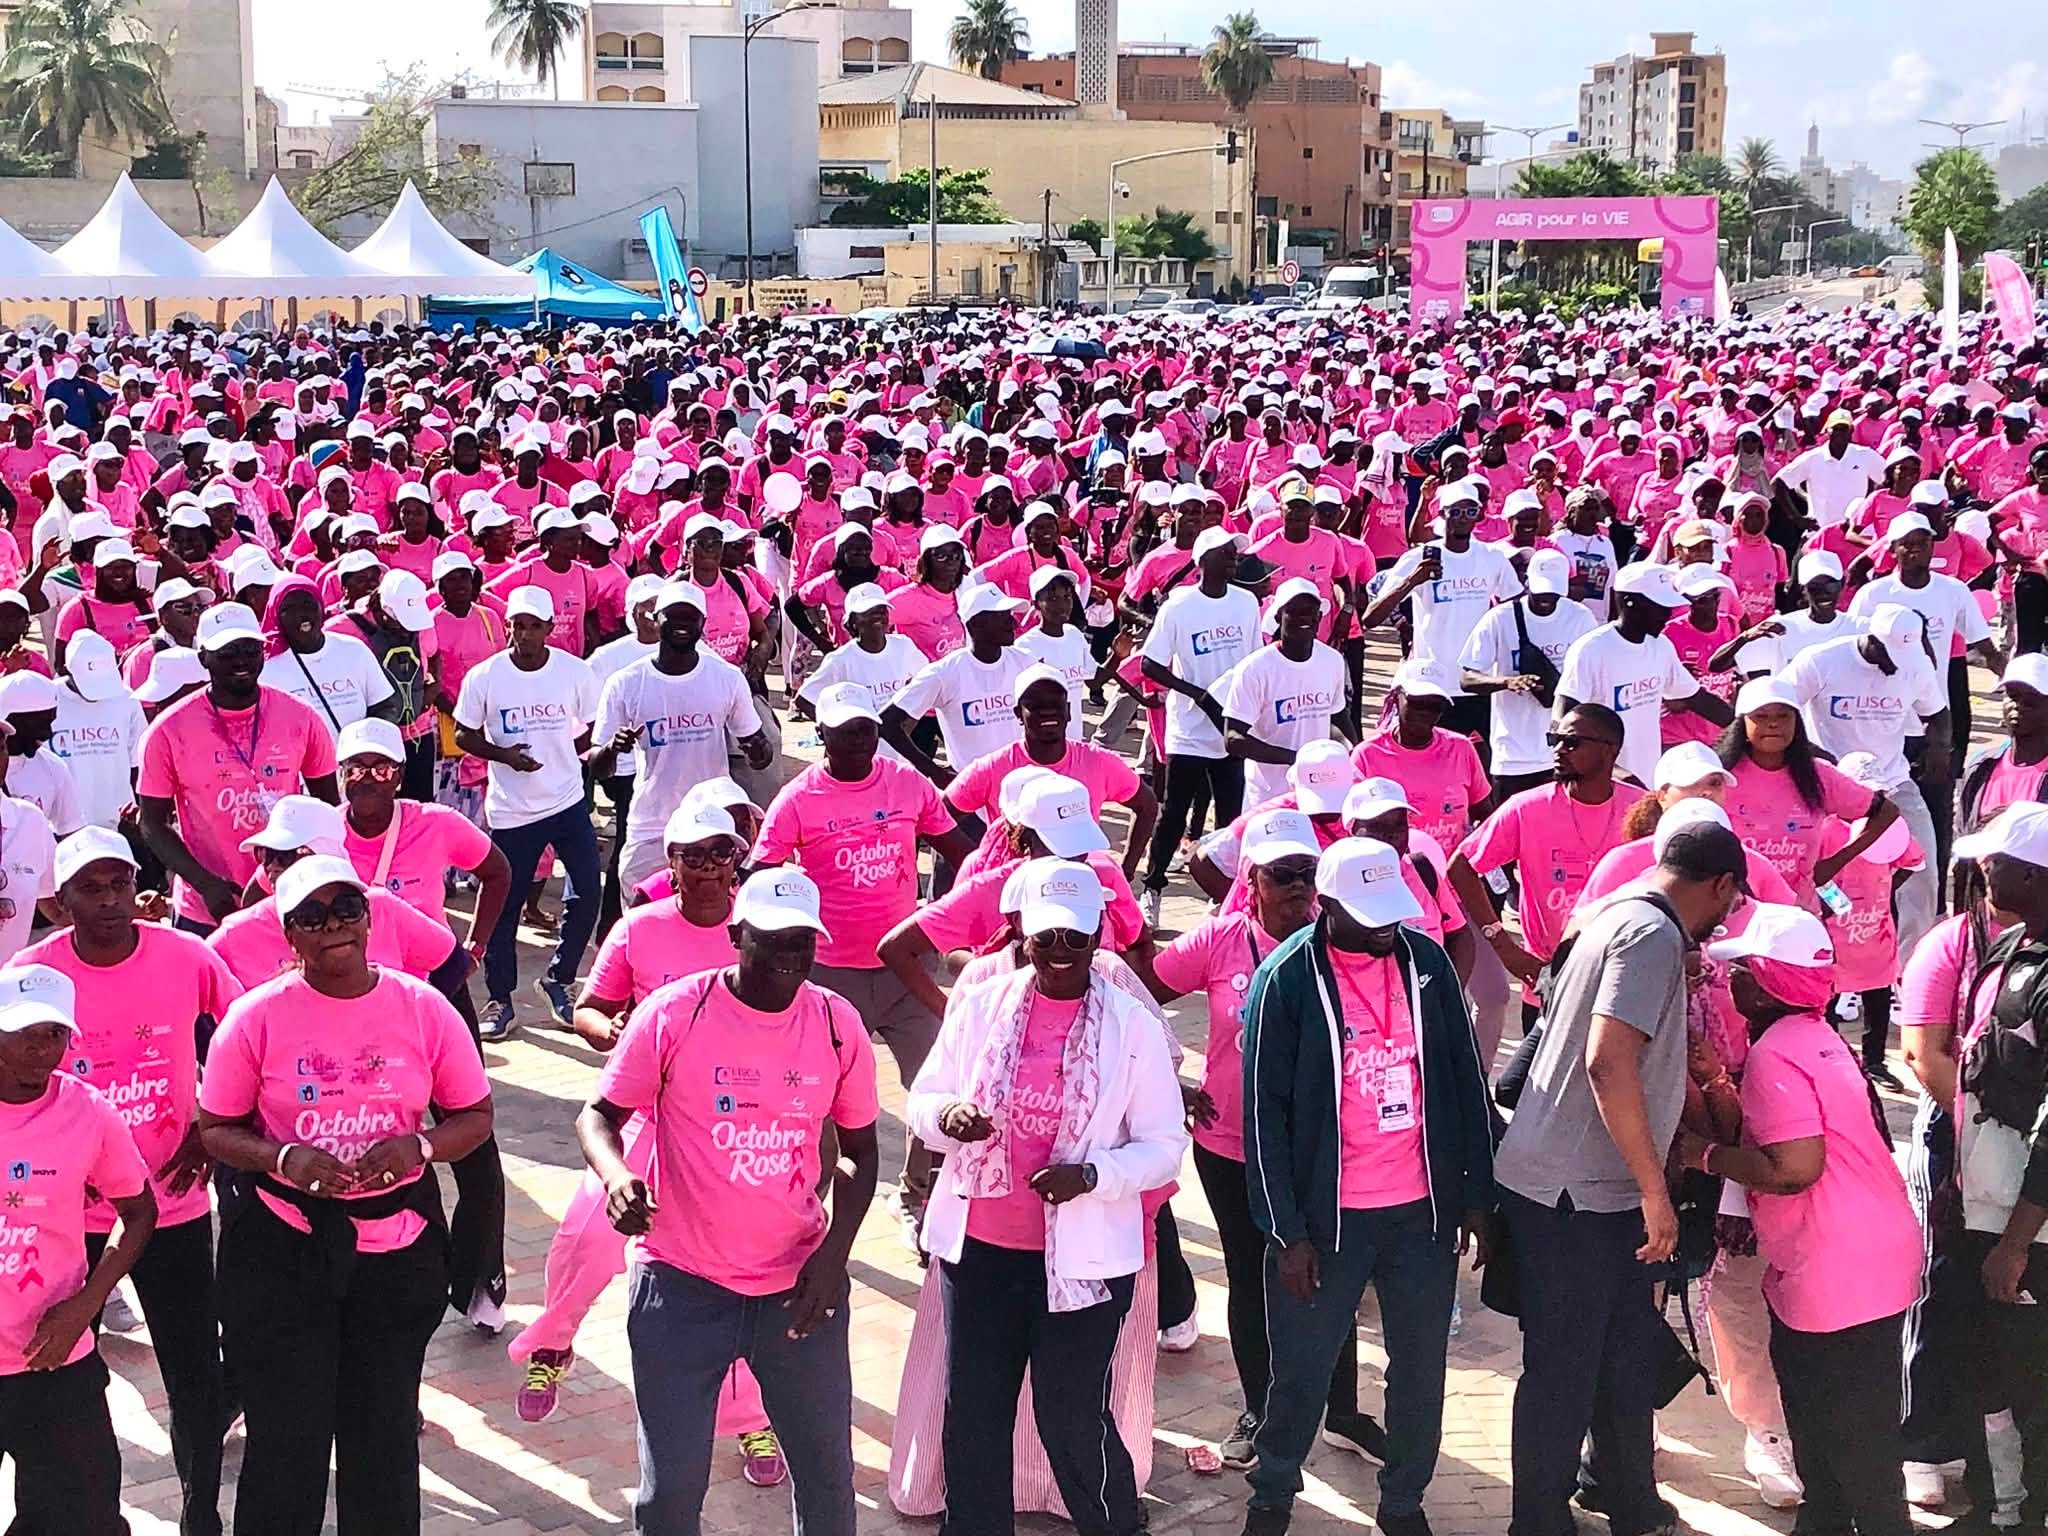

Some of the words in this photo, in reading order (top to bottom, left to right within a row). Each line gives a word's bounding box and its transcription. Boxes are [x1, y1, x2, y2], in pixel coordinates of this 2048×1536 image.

[1496, 213, 1533, 226] AGIR
[1537, 214, 1577, 229] pour
[1582, 212, 1597, 225] la
[1603, 211, 1629, 225] VIE
[1452, 576, 1488, 590] LISCA
[1210, 625, 1243, 641] LISCA
[308, 678, 356, 698] LSCA
[873, 679, 901, 696] LISC
[1633, 676, 1661, 694] LISC
[522, 703, 567, 719] LISCA
[984, 694, 1012, 711] LISC
[1856, 695, 1904, 710] LISCA
[668, 713, 714, 730] LISCA
[72, 727, 120, 742] LISCA
[835, 838, 902, 870] Octobre
[850, 860, 896, 888] Rose
[737, 1101, 759, 1109] wave
[119, 1102, 157, 1126] ose
[295, 1104, 396, 1141] Octobre
[711, 1120, 806, 1150] Octobre
[729, 1148, 791, 1186] Rose
